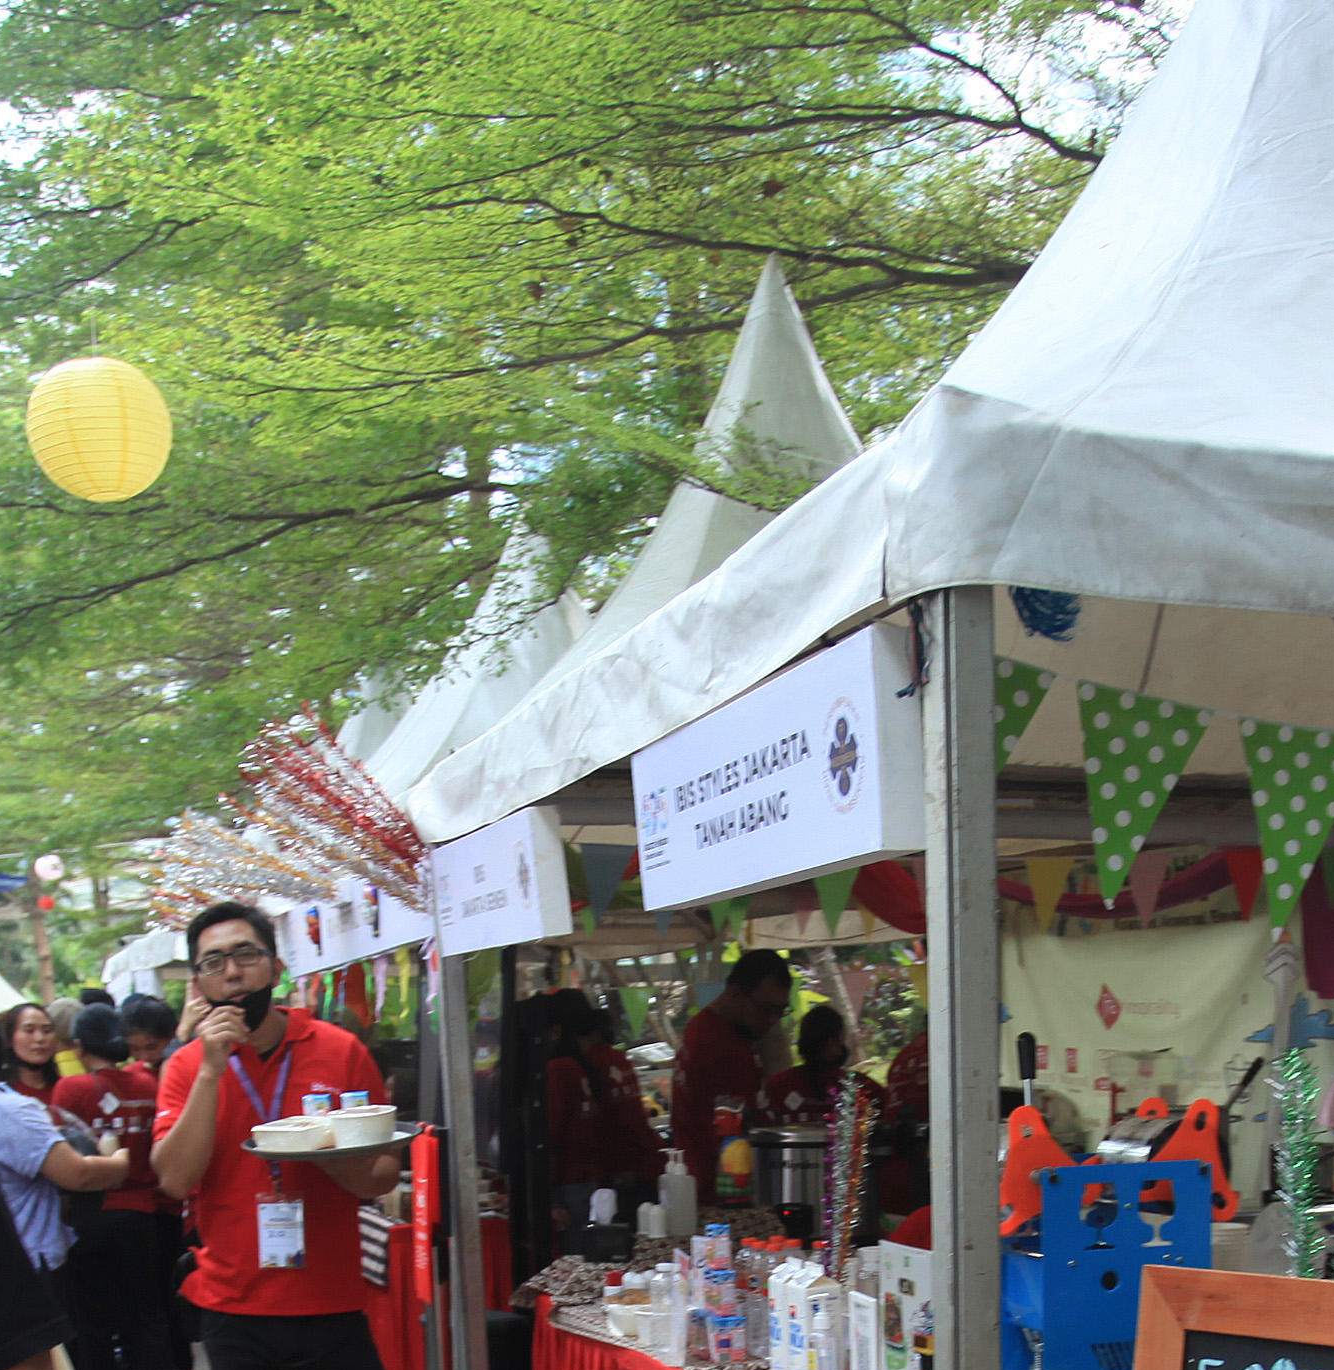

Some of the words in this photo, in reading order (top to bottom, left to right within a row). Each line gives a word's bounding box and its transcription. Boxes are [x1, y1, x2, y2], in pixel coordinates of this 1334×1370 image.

[698, 759, 740, 804] STYLES
[742, 729, 812, 785] JAKARTA
[694, 809, 738, 851] TANAH
[738, 789, 791, 837] ABANG
